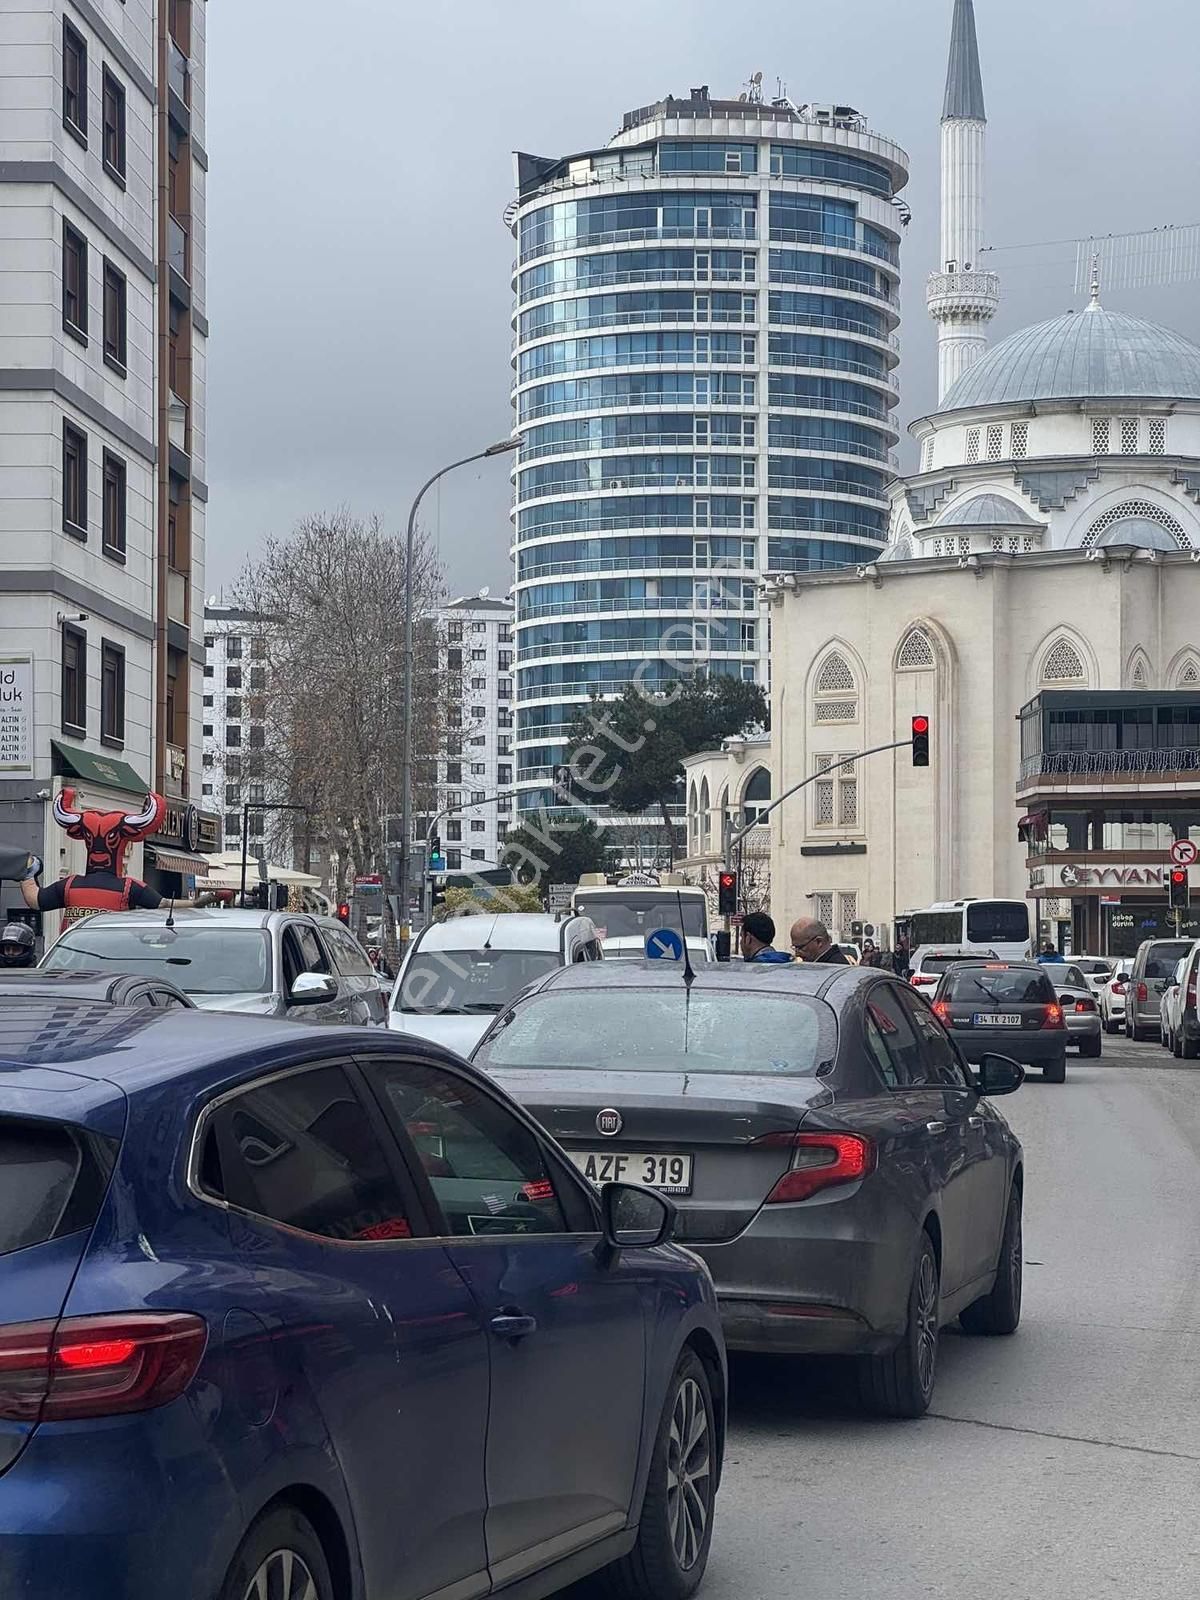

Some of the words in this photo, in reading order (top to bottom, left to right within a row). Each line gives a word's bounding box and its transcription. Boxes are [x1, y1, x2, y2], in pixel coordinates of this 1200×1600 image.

[1077, 867, 1163, 885] EYVAN
[979, 1015, 988, 1024] 34
[990, 1015, 1000, 1024] TK
[1002, 1015, 1020, 1024] 2107
[601, 1116, 617, 1129] FIAT
[584, 1154, 629, 1182] AZF
[641, 1156, 684, 1184] 319
